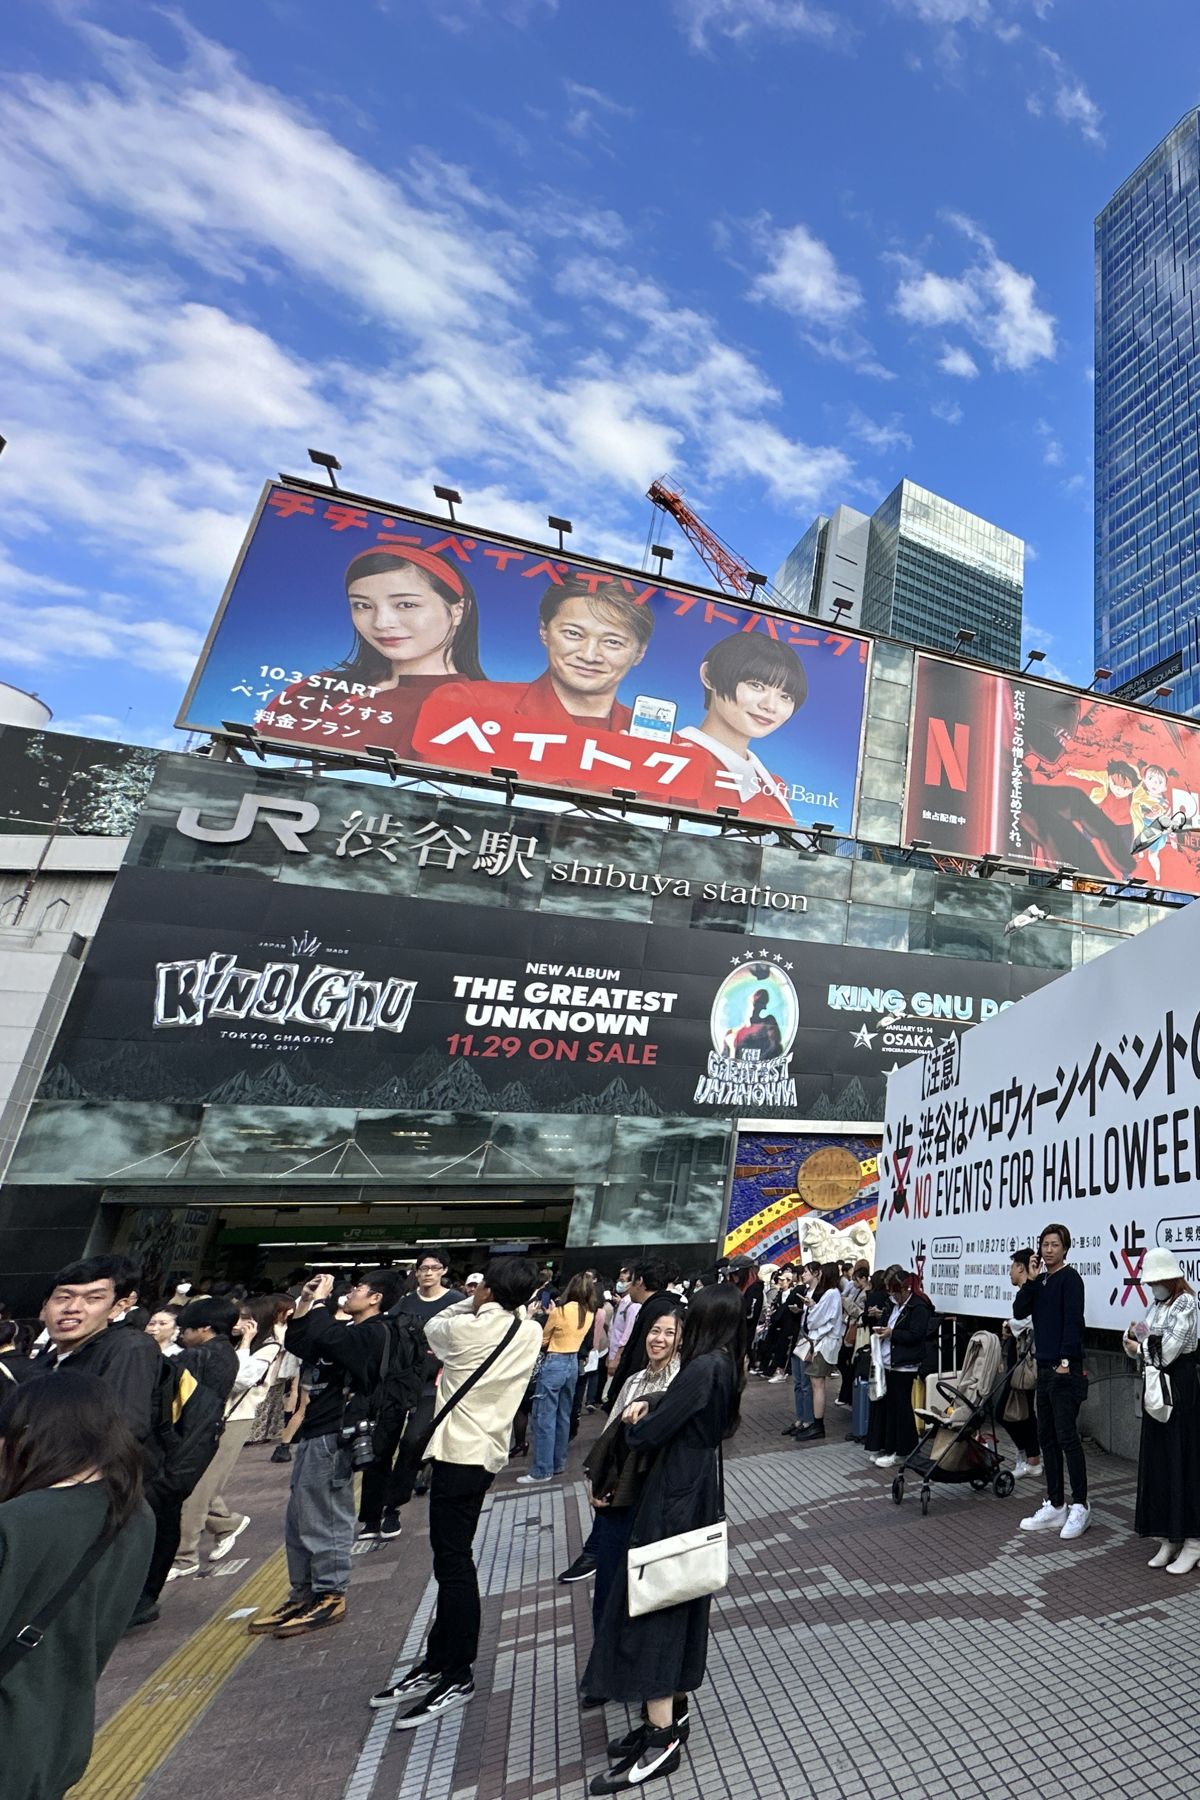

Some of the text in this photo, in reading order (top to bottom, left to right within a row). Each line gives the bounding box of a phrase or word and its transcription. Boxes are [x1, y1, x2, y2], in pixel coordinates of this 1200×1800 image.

[260, 665, 382, 699] 10.3 START
[1116, 676, 1146, 699] SHIBUYA
[1152, 663, 1181, 686] SQUARE
[231, 679, 393, 725] ペイしてトクする
[253, 708, 361, 738] 料金プラン
[428, 715, 692, 786] ペイトク
[924, 716, 970, 792] N
[749, 776, 840, 809] SoftBank
[922, 809, 966, 826] 独占配信中
[176, 792, 809, 913] JR 渋谷駅 shibuya station
[258, 941, 349, 955] JAPAN MADE
[525, 962, 621, 982] NEW ALBUM
[453, 975, 678, 1013] THE GREATEST
[827, 984, 907, 1013] KING
[911, 991, 973, 1020] GNU
[465, 1004, 650, 1037] UNKNOWN
[885, 1024, 915, 1033] JANUARY
[219, 1030, 335, 1045] TOKYO CHAOTIC
[447, 1033, 659, 1066] 11.29 ON SALE
[882, 1032, 934, 1048] OSAKA
[914, 1172, 932, 1220] NO
[935, 1157, 993, 1218] EVENTS
[999, 1148, 1034, 1210] FOR
